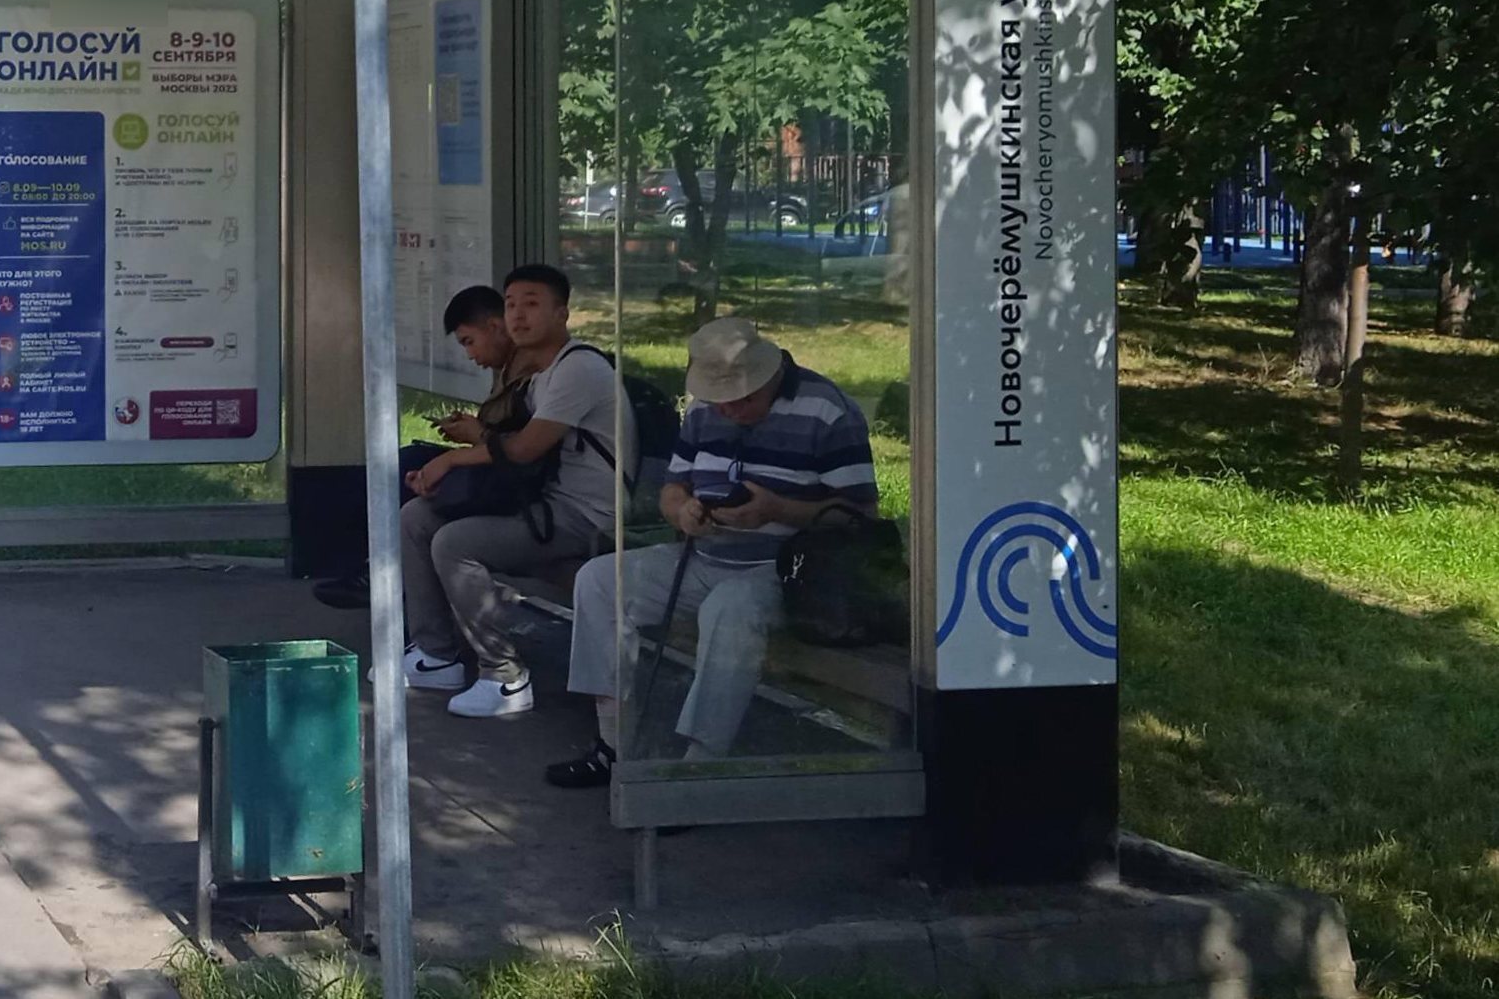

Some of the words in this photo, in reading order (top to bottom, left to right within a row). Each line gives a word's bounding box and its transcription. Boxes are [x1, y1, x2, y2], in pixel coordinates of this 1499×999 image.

[170, 32, 236, 48] 8-9-10
[152, 51, 236, 62] СЕНТЯБРЯ
[152, 74, 202, 83] ВЫБОРЫ
[205, 74, 238, 83] МЭРА
[161, 85, 210, 94] МОСКВЫ
[213, 85, 238, 94] 2023
[157, 112, 240, 127] ГОЛОСУЙ
[157, 129, 235, 144] ОНЛАЙН
[115, 156, 124, 166] 1.
[51, 193, 66, 201] ДО
[115, 208, 126, 218] 2.
[994, 20, 1027, 447] Новочерёмушкинская
[115, 261, 127, 271] 3.
[115, 326, 127, 336] 4.
